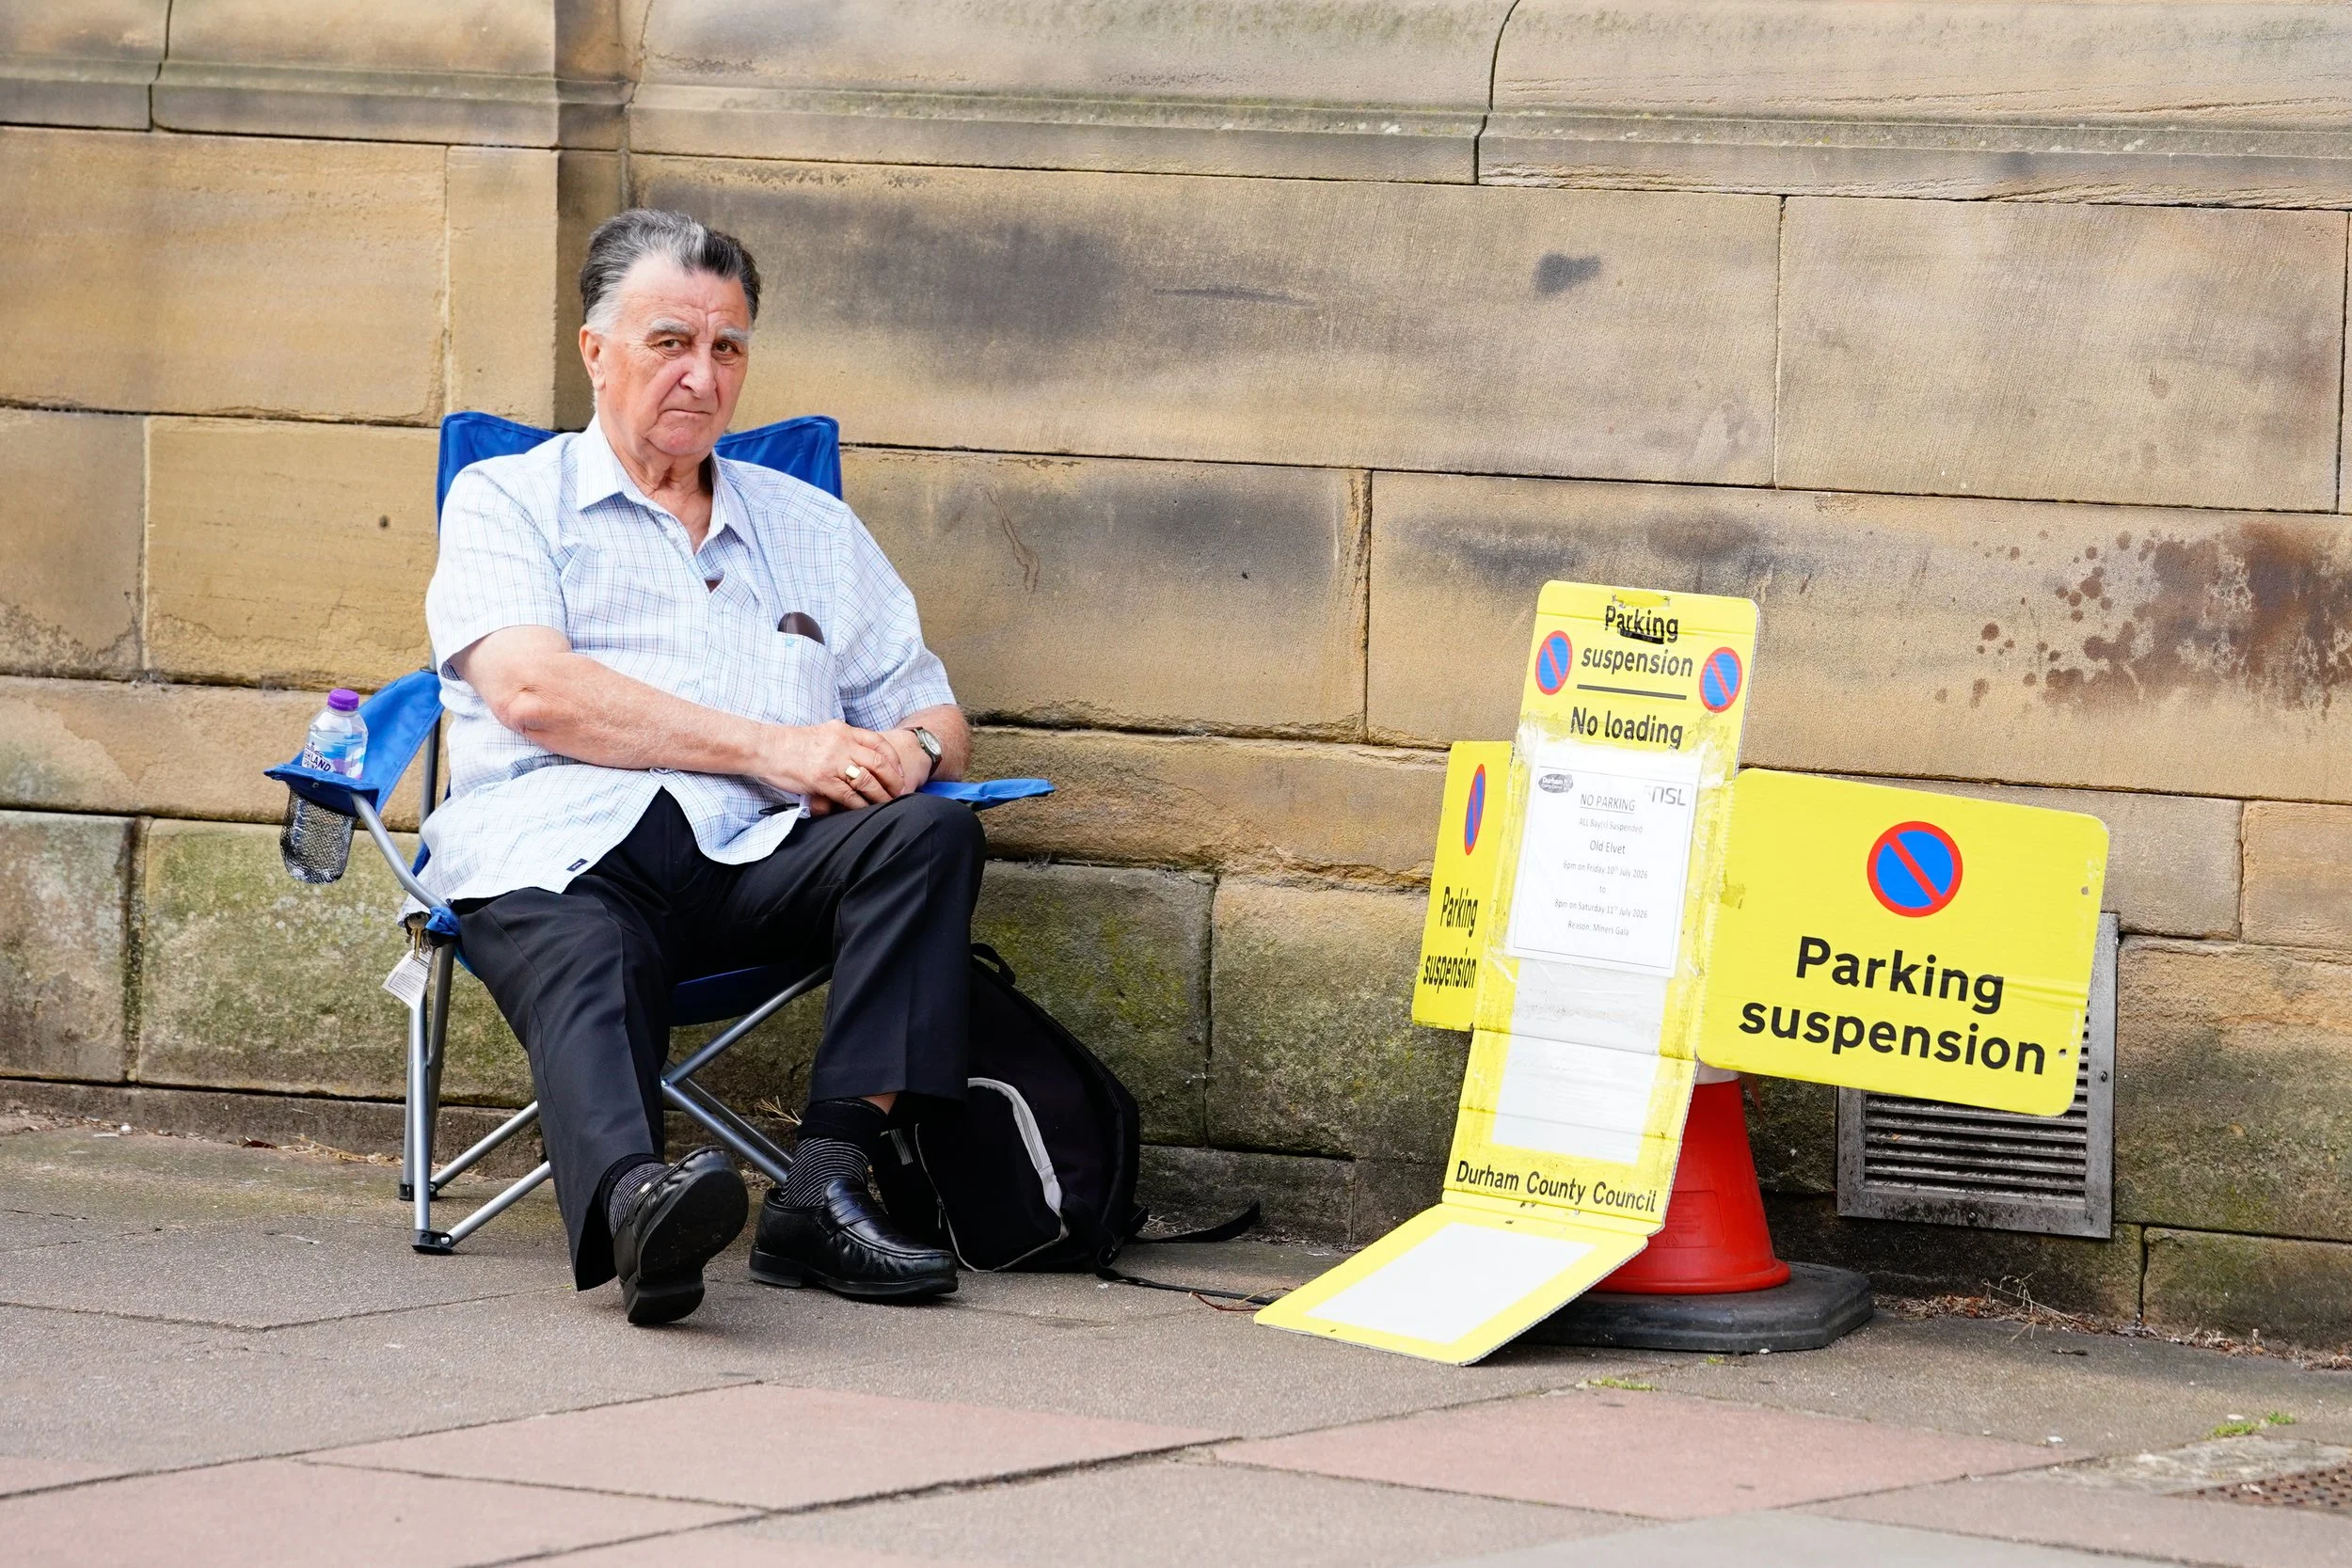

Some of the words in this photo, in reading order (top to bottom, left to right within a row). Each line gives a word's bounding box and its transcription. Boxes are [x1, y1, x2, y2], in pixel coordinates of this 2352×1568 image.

[1605, 605, 1679, 643] Parking
[1581, 647, 1693, 677] suspension
[1570, 706, 1598, 736] No
[1604, 710, 1683, 750] loading
[1581, 794, 1594, 806] NO
[1596, 796, 1636, 812] PARKING
[1579, 817, 1588, 827] ALL
[1590, 818, 1609, 831] Bay(s)
[1610, 821, 1643, 833] Suspended
[1590, 840, 1603, 851] Old
[1606, 842, 1626, 854] Elvet
[1586, 863, 1605, 875] Friday
[1619, 868, 1630, 879] July
[1633, 869, 1648, 879] 2026
[1599, 885, 1606, 894] to
[1439, 886, 1478, 938] Parking
[1578, 901, 1605, 914] Saturday
[1619, 908, 1631, 918] July
[1632, 909, 1648, 918] 2026
[1593, 924, 1613, 934] Miners
[1615, 927, 1629, 936] Gala
[1423, 947, 1476, 994] suspension
[1796, 935, 2004, 1015] Parking
[1739, 1002, 2046, 1075] suspension
[1456, 1160, 1519, 1191] Durham
[1526, 1171, 1586, 1205] County
[1593, 1181, 1657, 1212] Council
